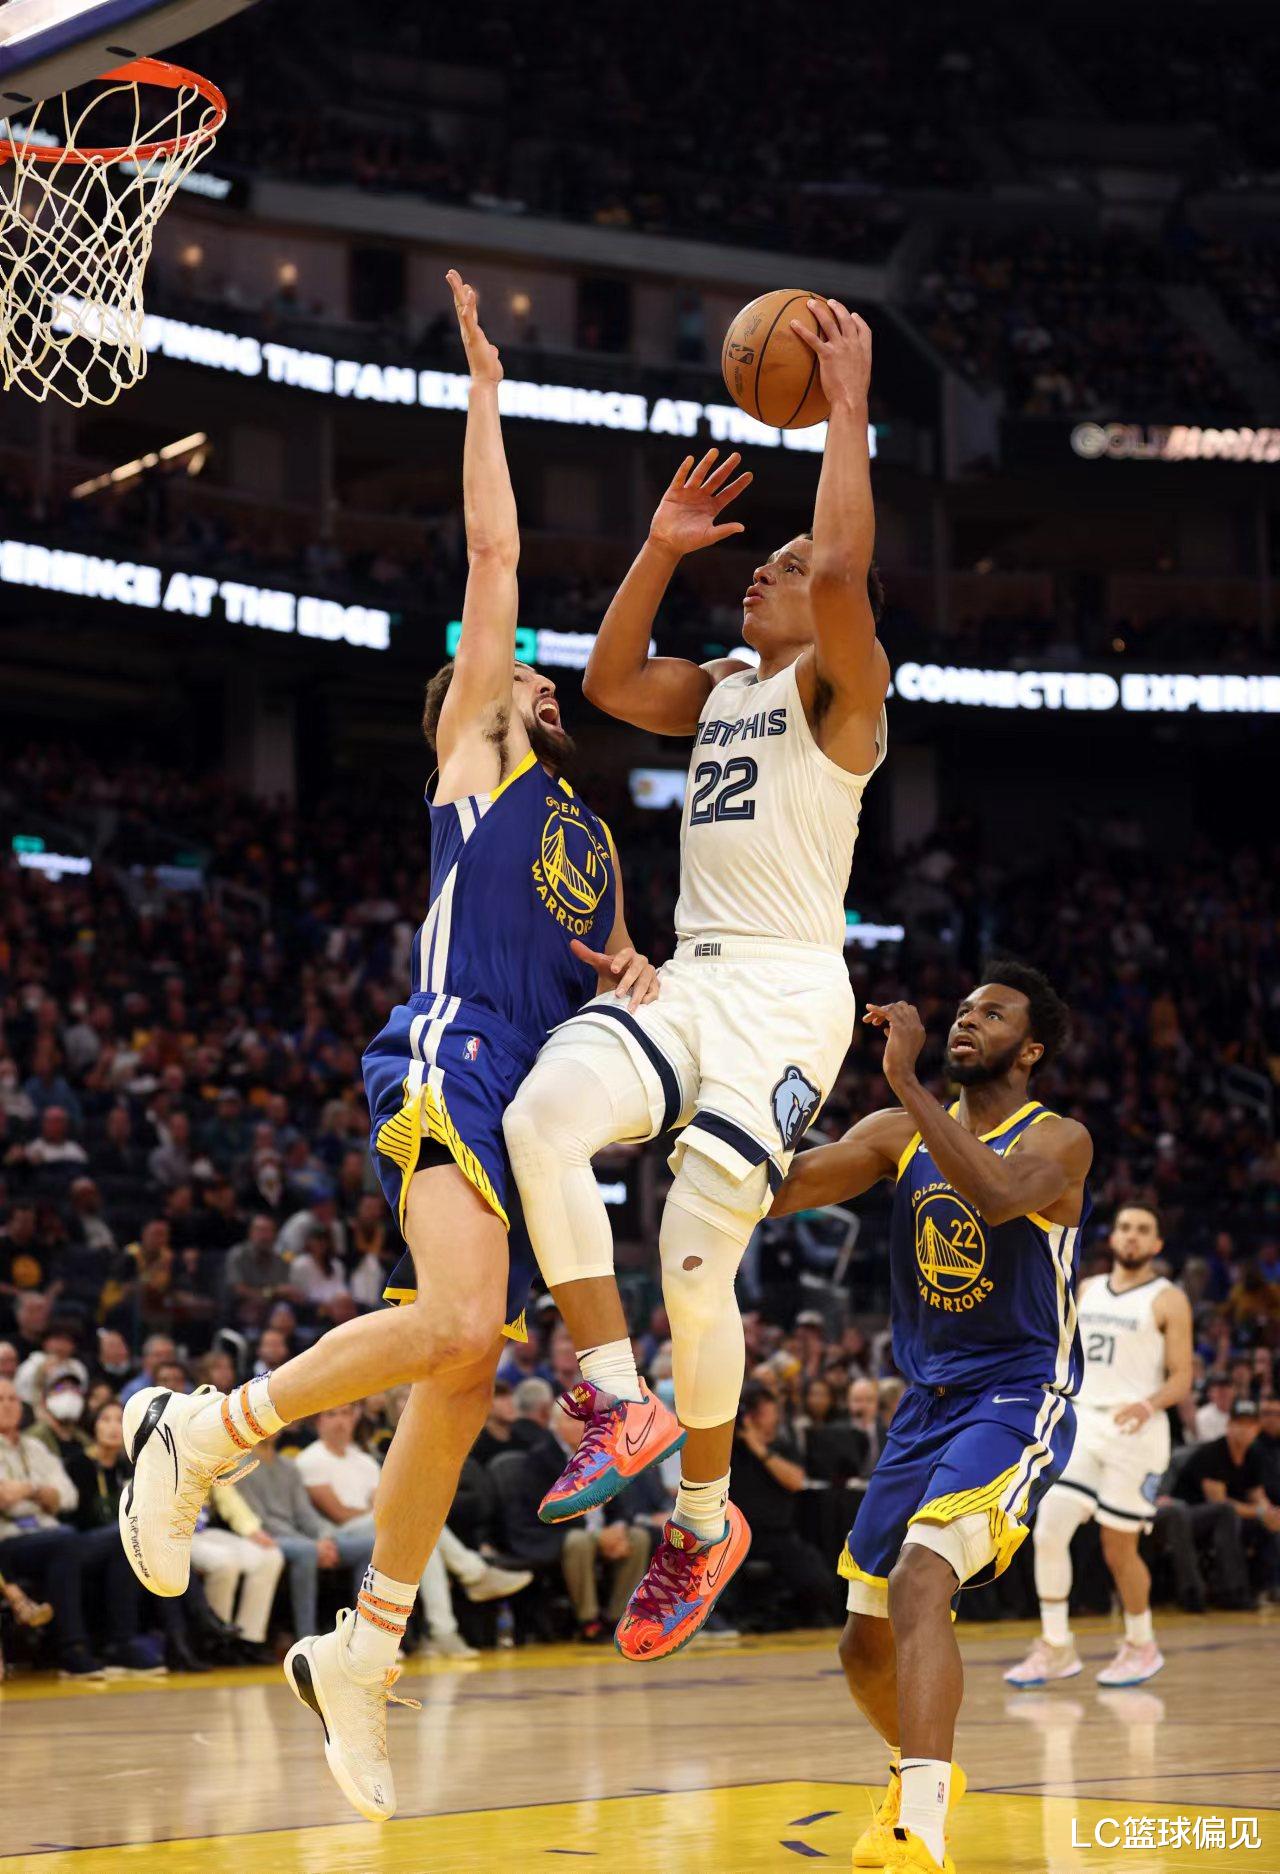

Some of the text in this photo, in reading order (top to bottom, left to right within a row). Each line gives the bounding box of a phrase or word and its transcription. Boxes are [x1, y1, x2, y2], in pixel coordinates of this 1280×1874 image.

[690, 756, 758, 826] 22
[950, 1219, 978, 1249] 22
[1087, 1334, 1115, 1366] 21
